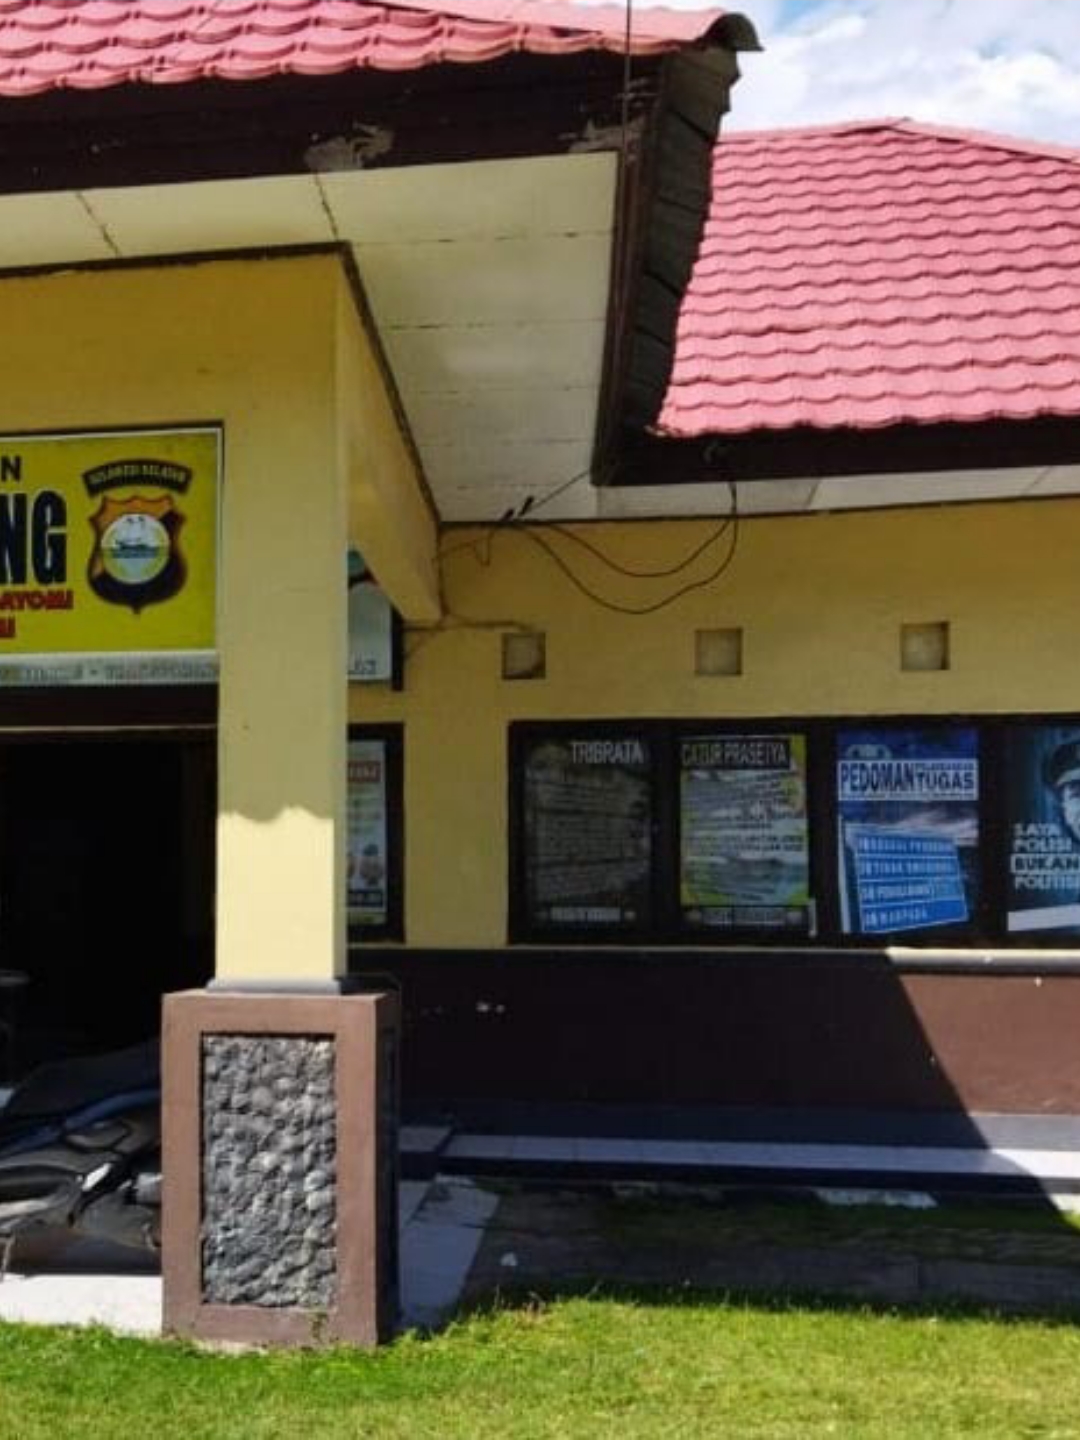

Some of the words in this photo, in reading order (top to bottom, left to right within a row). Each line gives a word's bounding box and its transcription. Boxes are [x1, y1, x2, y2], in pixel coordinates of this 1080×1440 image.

[570, 740, 645, 765] TRIBRATA
[841, 762, 913, 792] PEDOMAN
[915, 772, 975, 791] TUGAS
